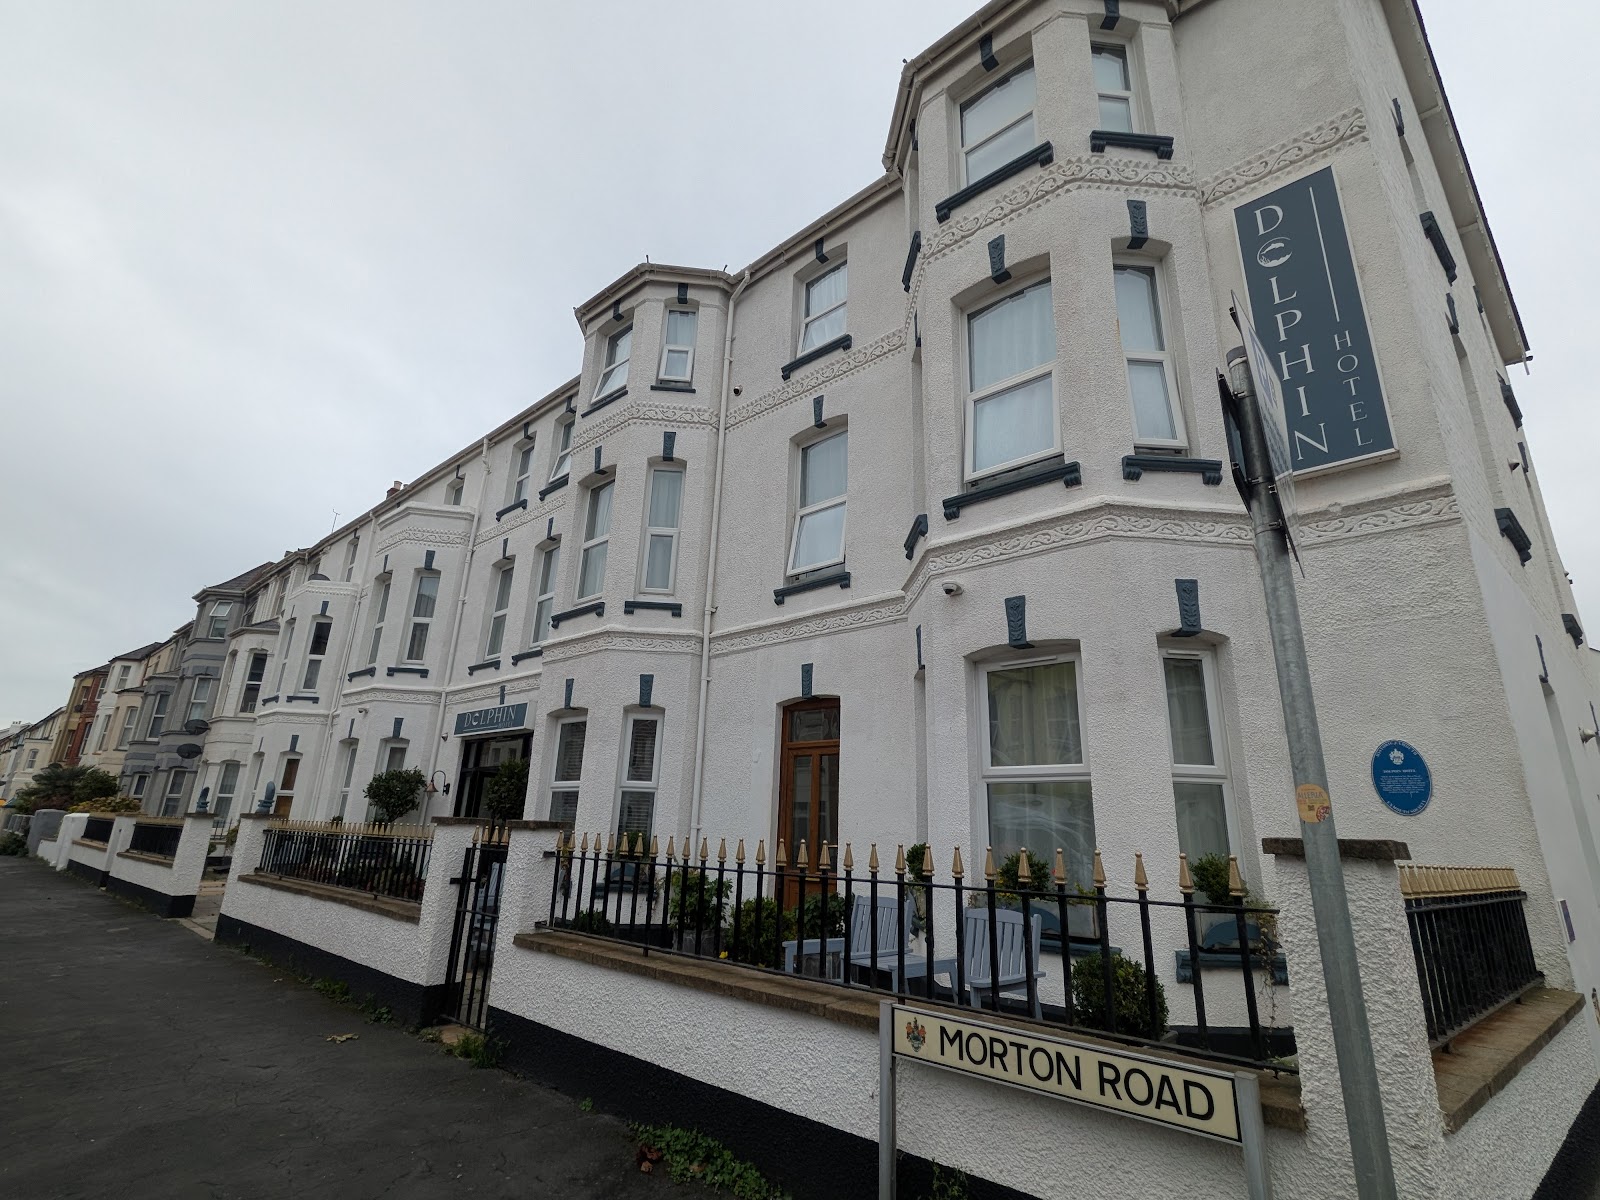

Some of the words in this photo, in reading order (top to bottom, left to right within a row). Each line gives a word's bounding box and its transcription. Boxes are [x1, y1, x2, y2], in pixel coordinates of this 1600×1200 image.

[1254, 205, 1329, 461] DOLPHIN
[1334, 330, 1373, 447] HOTEL
[464, 705, 517, 728] DOLPHIN
[939, 1025, 1082, 1091] MORTON
[1097, 1060, 1215, 1121] ROAD
